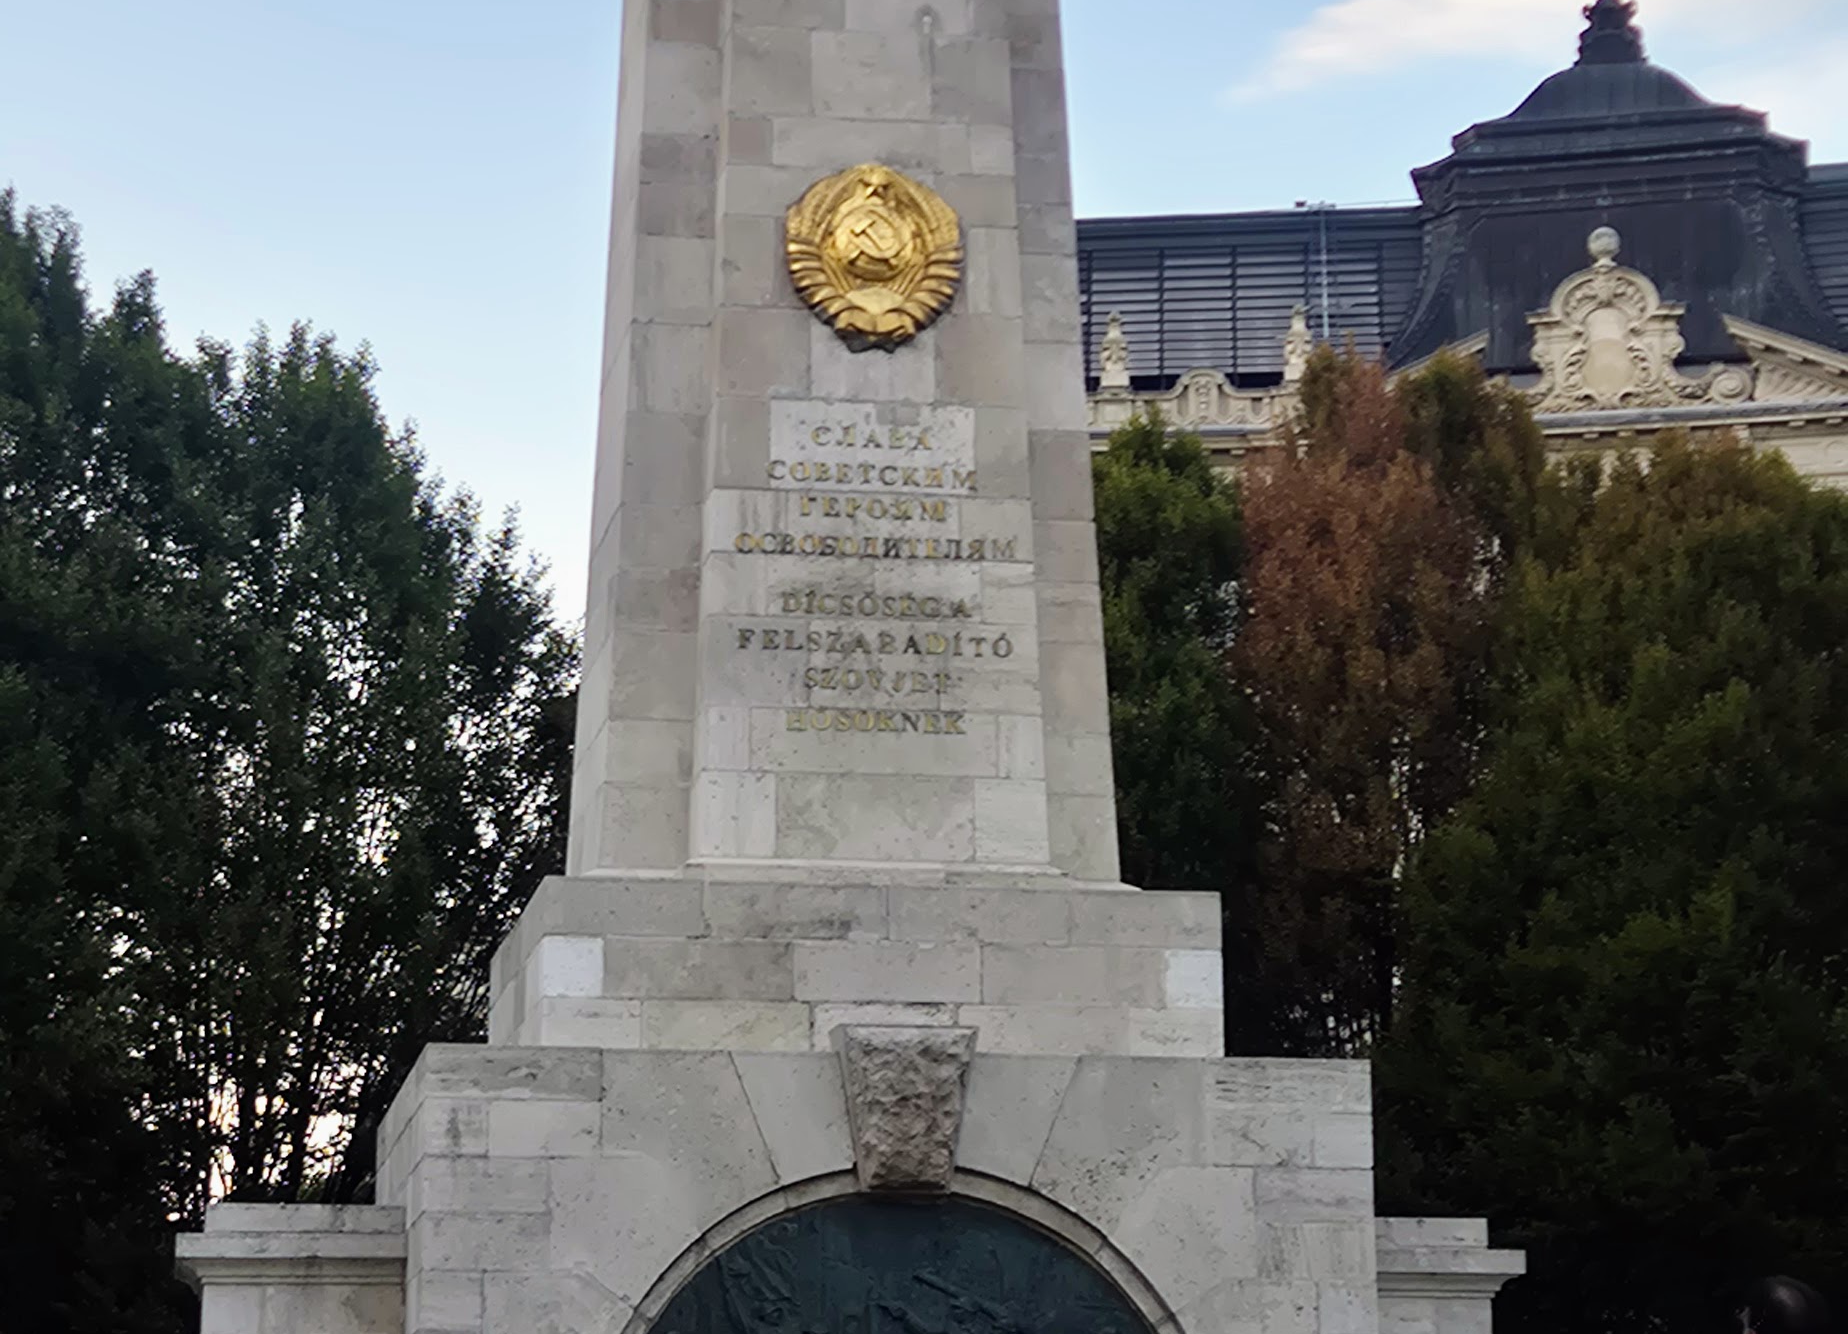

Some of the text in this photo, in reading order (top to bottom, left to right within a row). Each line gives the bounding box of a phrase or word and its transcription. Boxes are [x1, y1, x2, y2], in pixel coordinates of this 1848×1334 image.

[810, 423, 933, 451] СЛАВА
[766, 460, 978, 492] СОВЕТСКИМ
[800, 495, 947, 522] ГЕРОЯМ
[734, 532, 1017, 560] ОСВОБОДИТЕЛЯМ
[950, 597, 973, 618] A
[737, 627, 1014, 658] FELSZABADÍTÓ
[804, 667, 951, 697] SZOVJET
